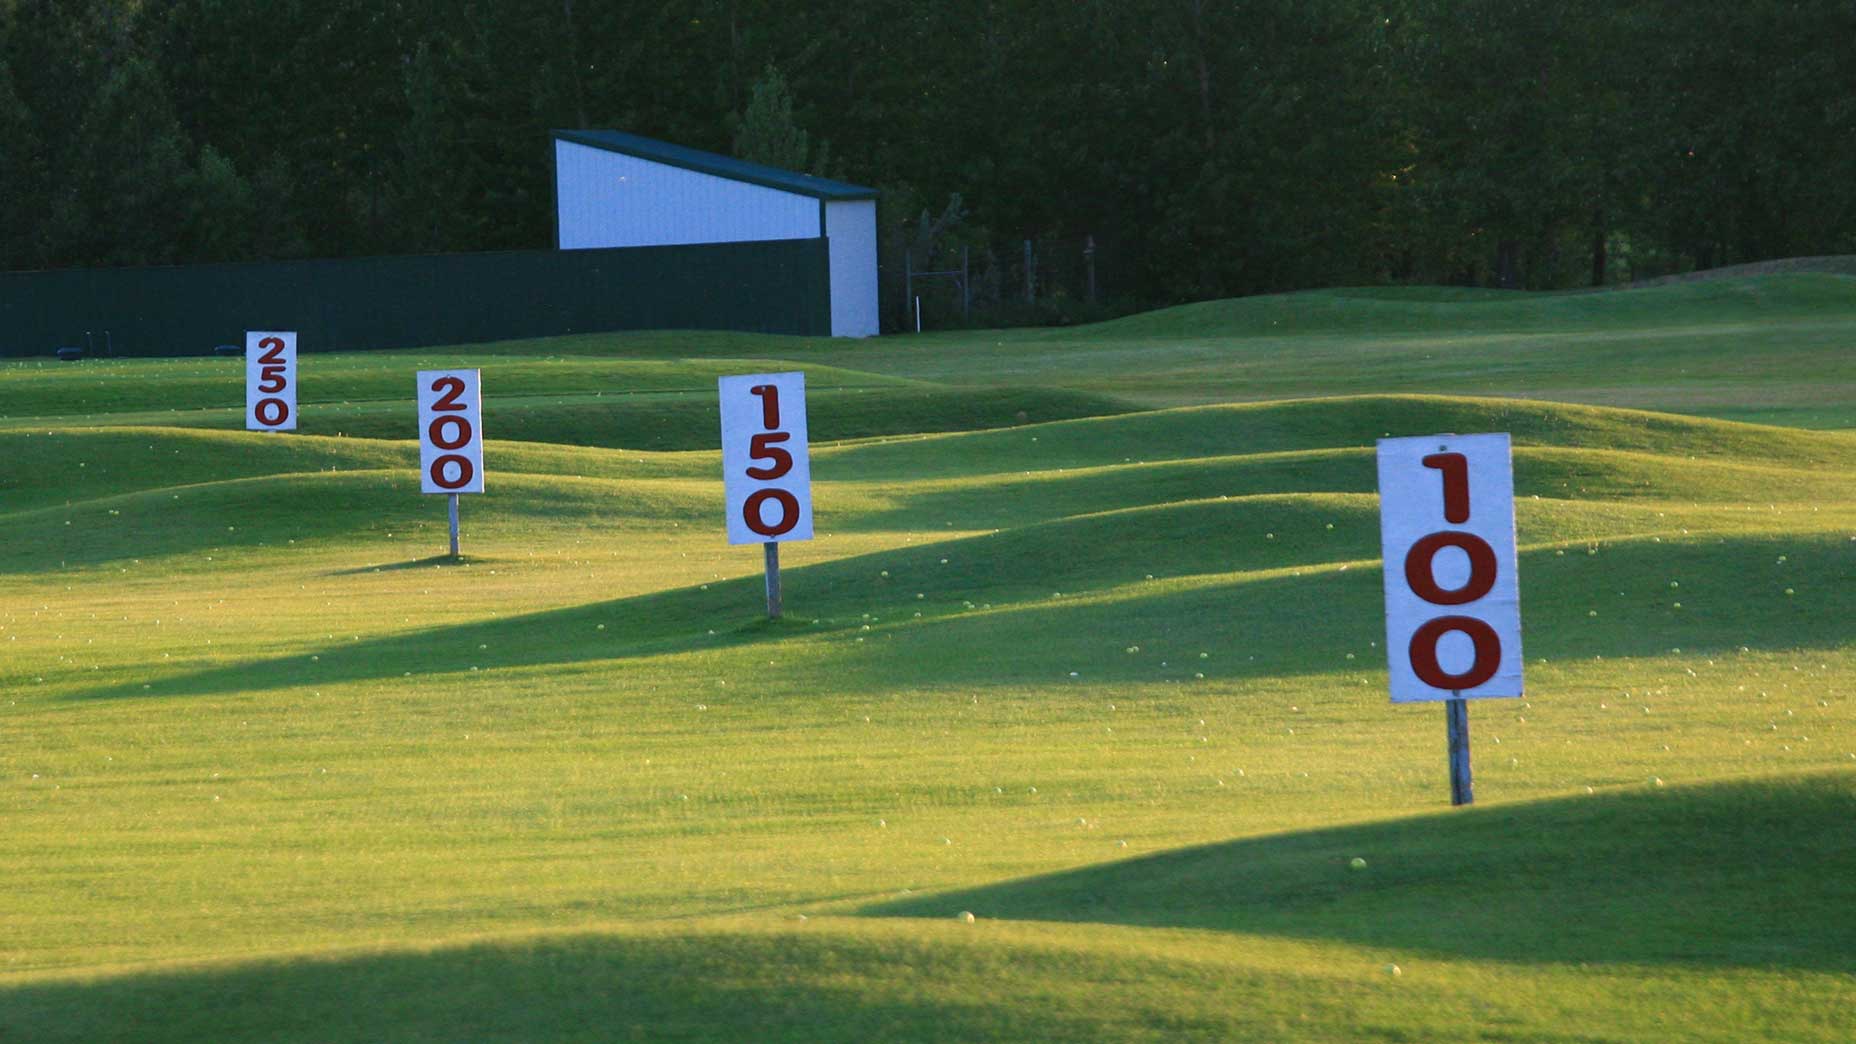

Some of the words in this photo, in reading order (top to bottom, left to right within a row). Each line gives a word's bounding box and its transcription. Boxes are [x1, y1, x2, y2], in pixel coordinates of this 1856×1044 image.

[254, 337, 289, 426] 250
[429, 377, 473, 489] 200
[743, 385, 799, 537] 150
[1405, 452, 1501, 690] 100
